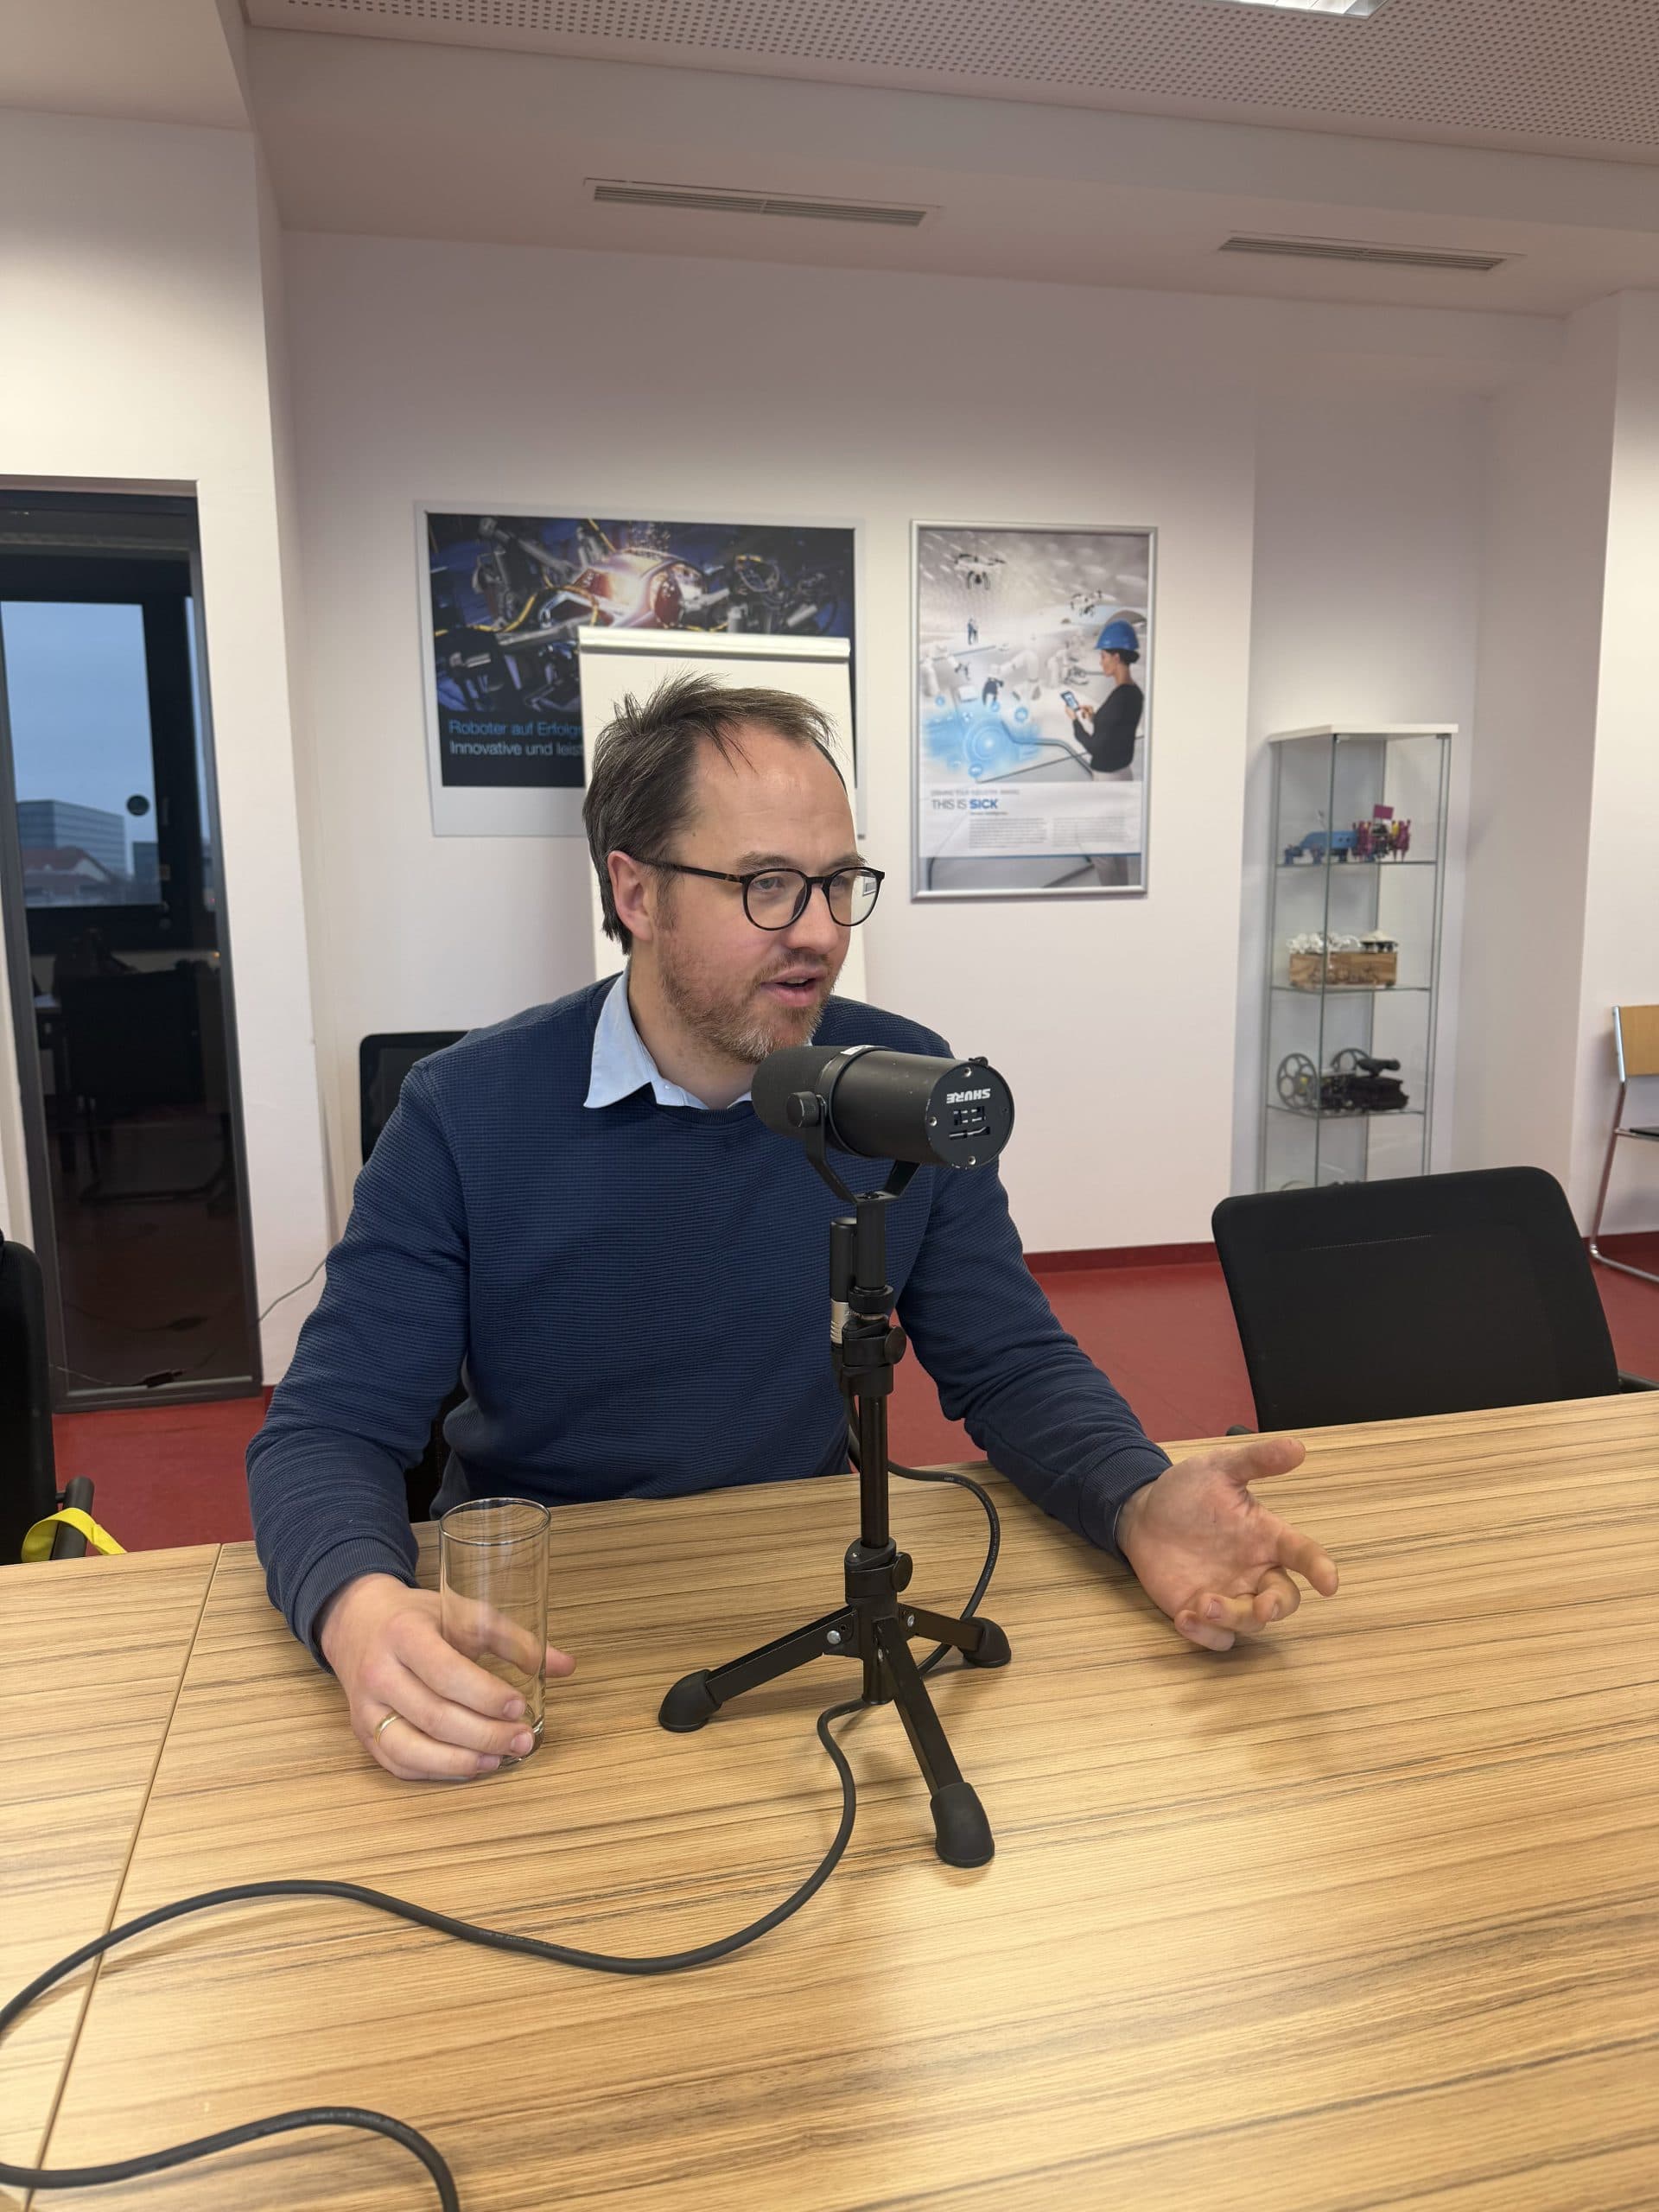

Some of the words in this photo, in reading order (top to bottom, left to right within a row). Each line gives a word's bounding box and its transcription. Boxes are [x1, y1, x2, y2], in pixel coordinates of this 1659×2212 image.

[449, 720, 505, 734] Roboter
[512, 721, 532, 734] auf
[449, 741, 521, 755] Innovative
[525, 741, 553, 755] und
[931, 798, 955, 810] THIS
[957, 798, 968, 810] IS
[969, 798, 998, 810] SICK
[946, 1088, 991, 1104] SHURE
